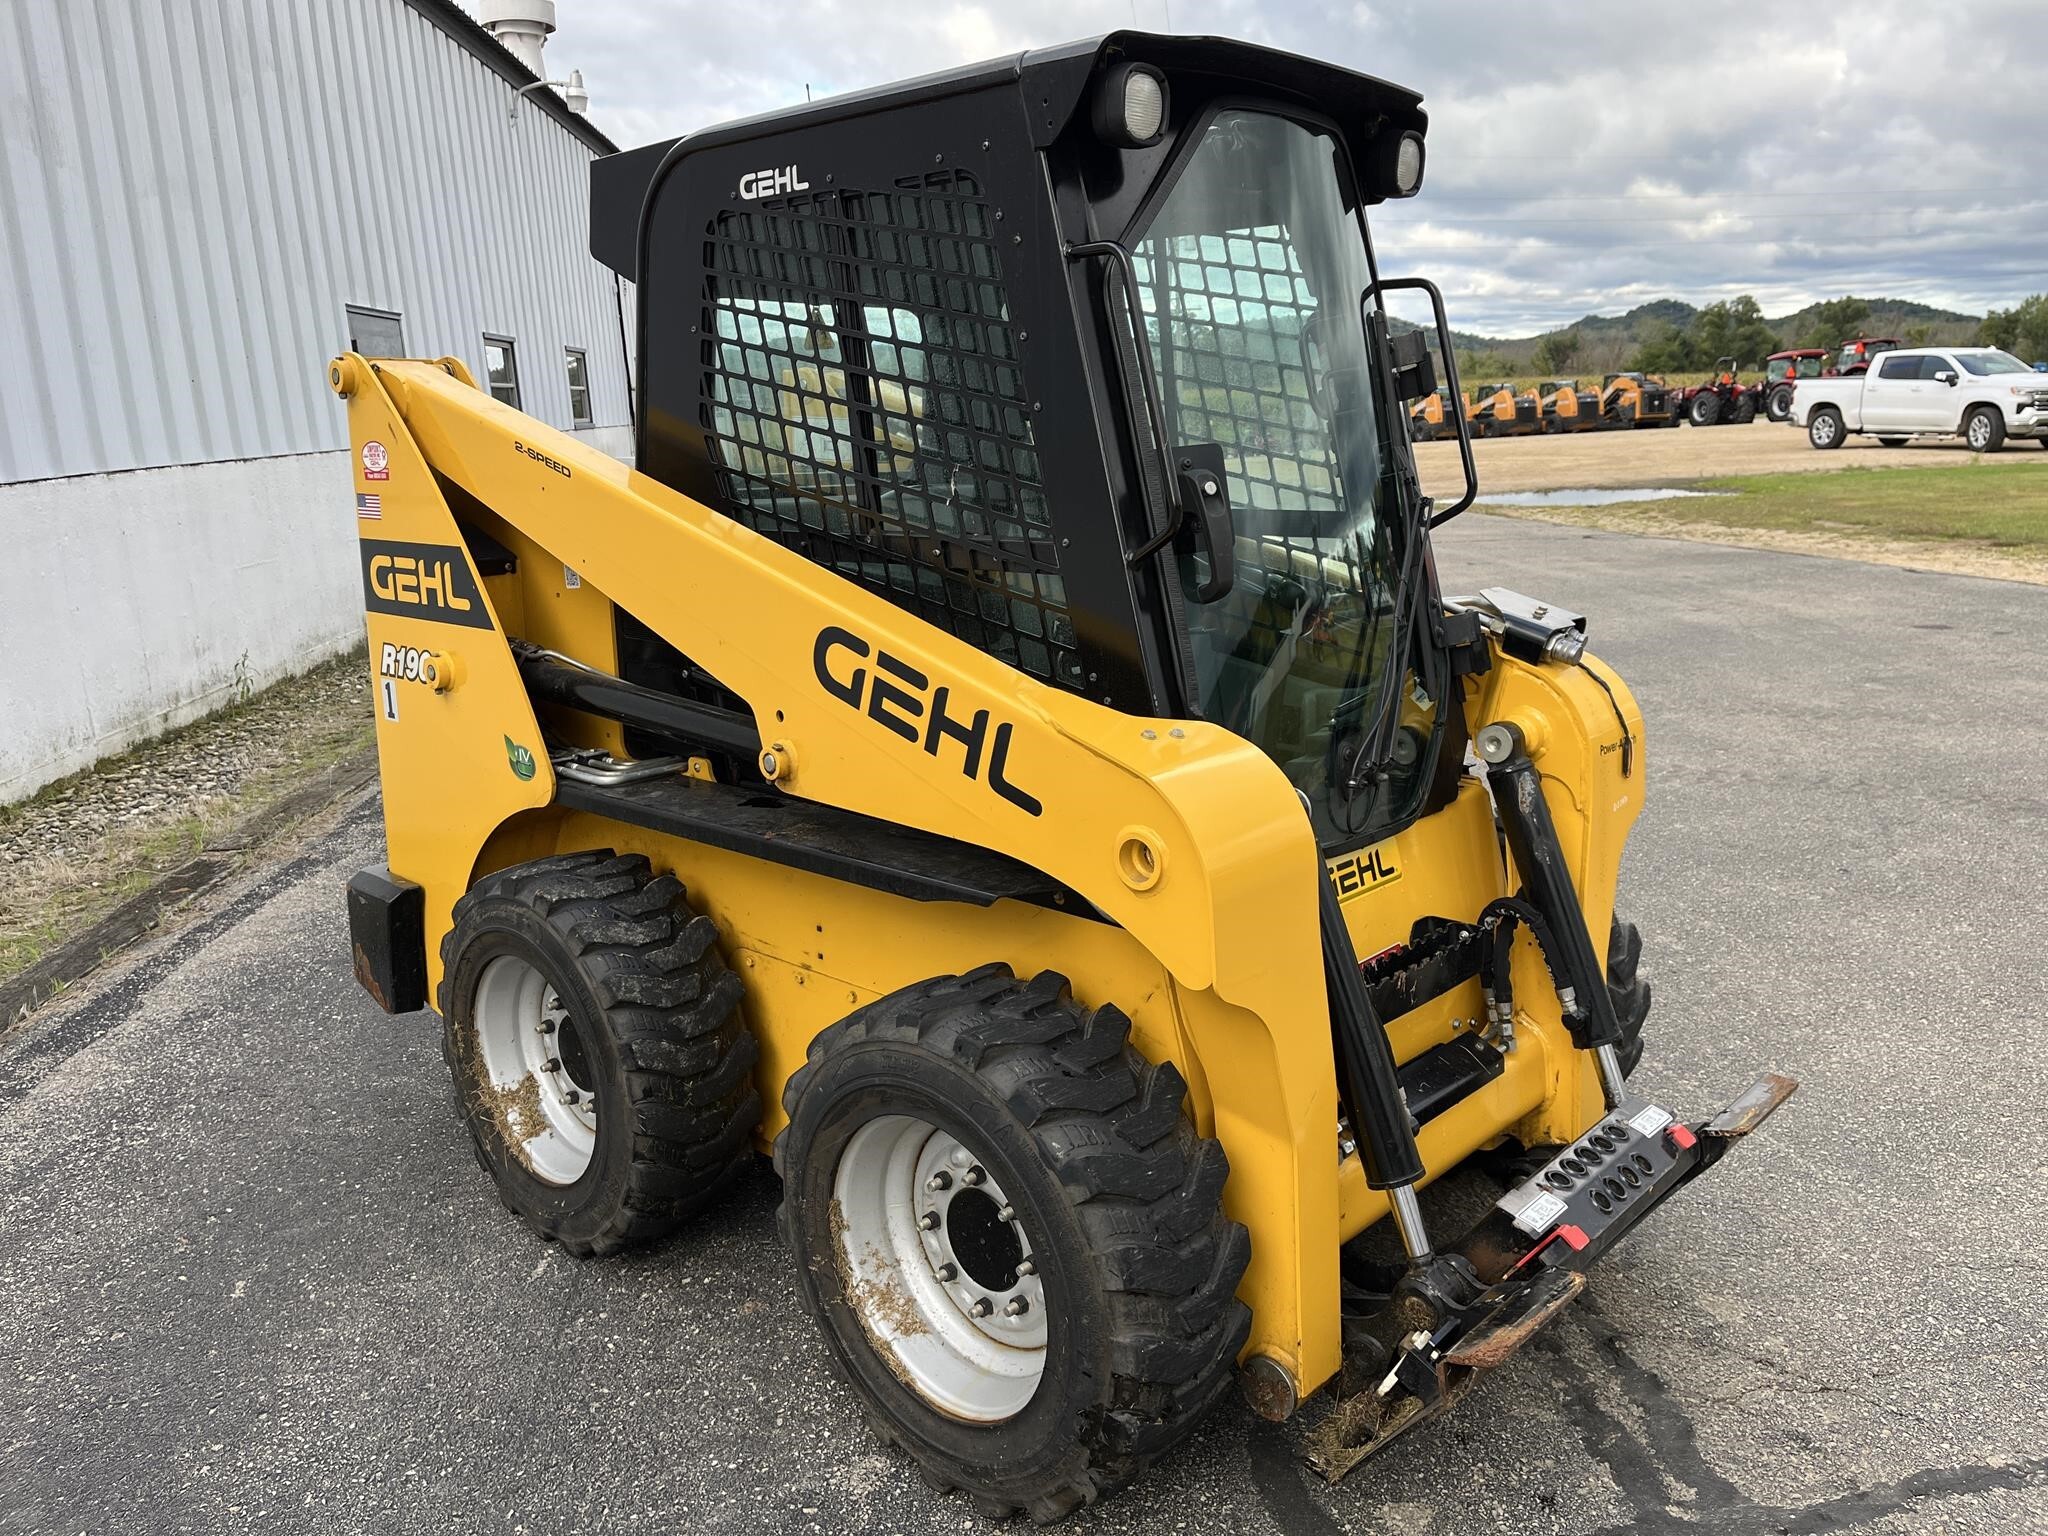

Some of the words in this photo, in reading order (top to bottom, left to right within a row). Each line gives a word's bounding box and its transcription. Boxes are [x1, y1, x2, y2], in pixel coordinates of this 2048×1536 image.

[740, 164, 809, 200] GEHL
[514, 440, 571, 478] 2-SPEED
[370, 554, 471, 611] GEHL
[384, 681, 396, 719] 1
[813, 626, 1043, 817] GEHL
